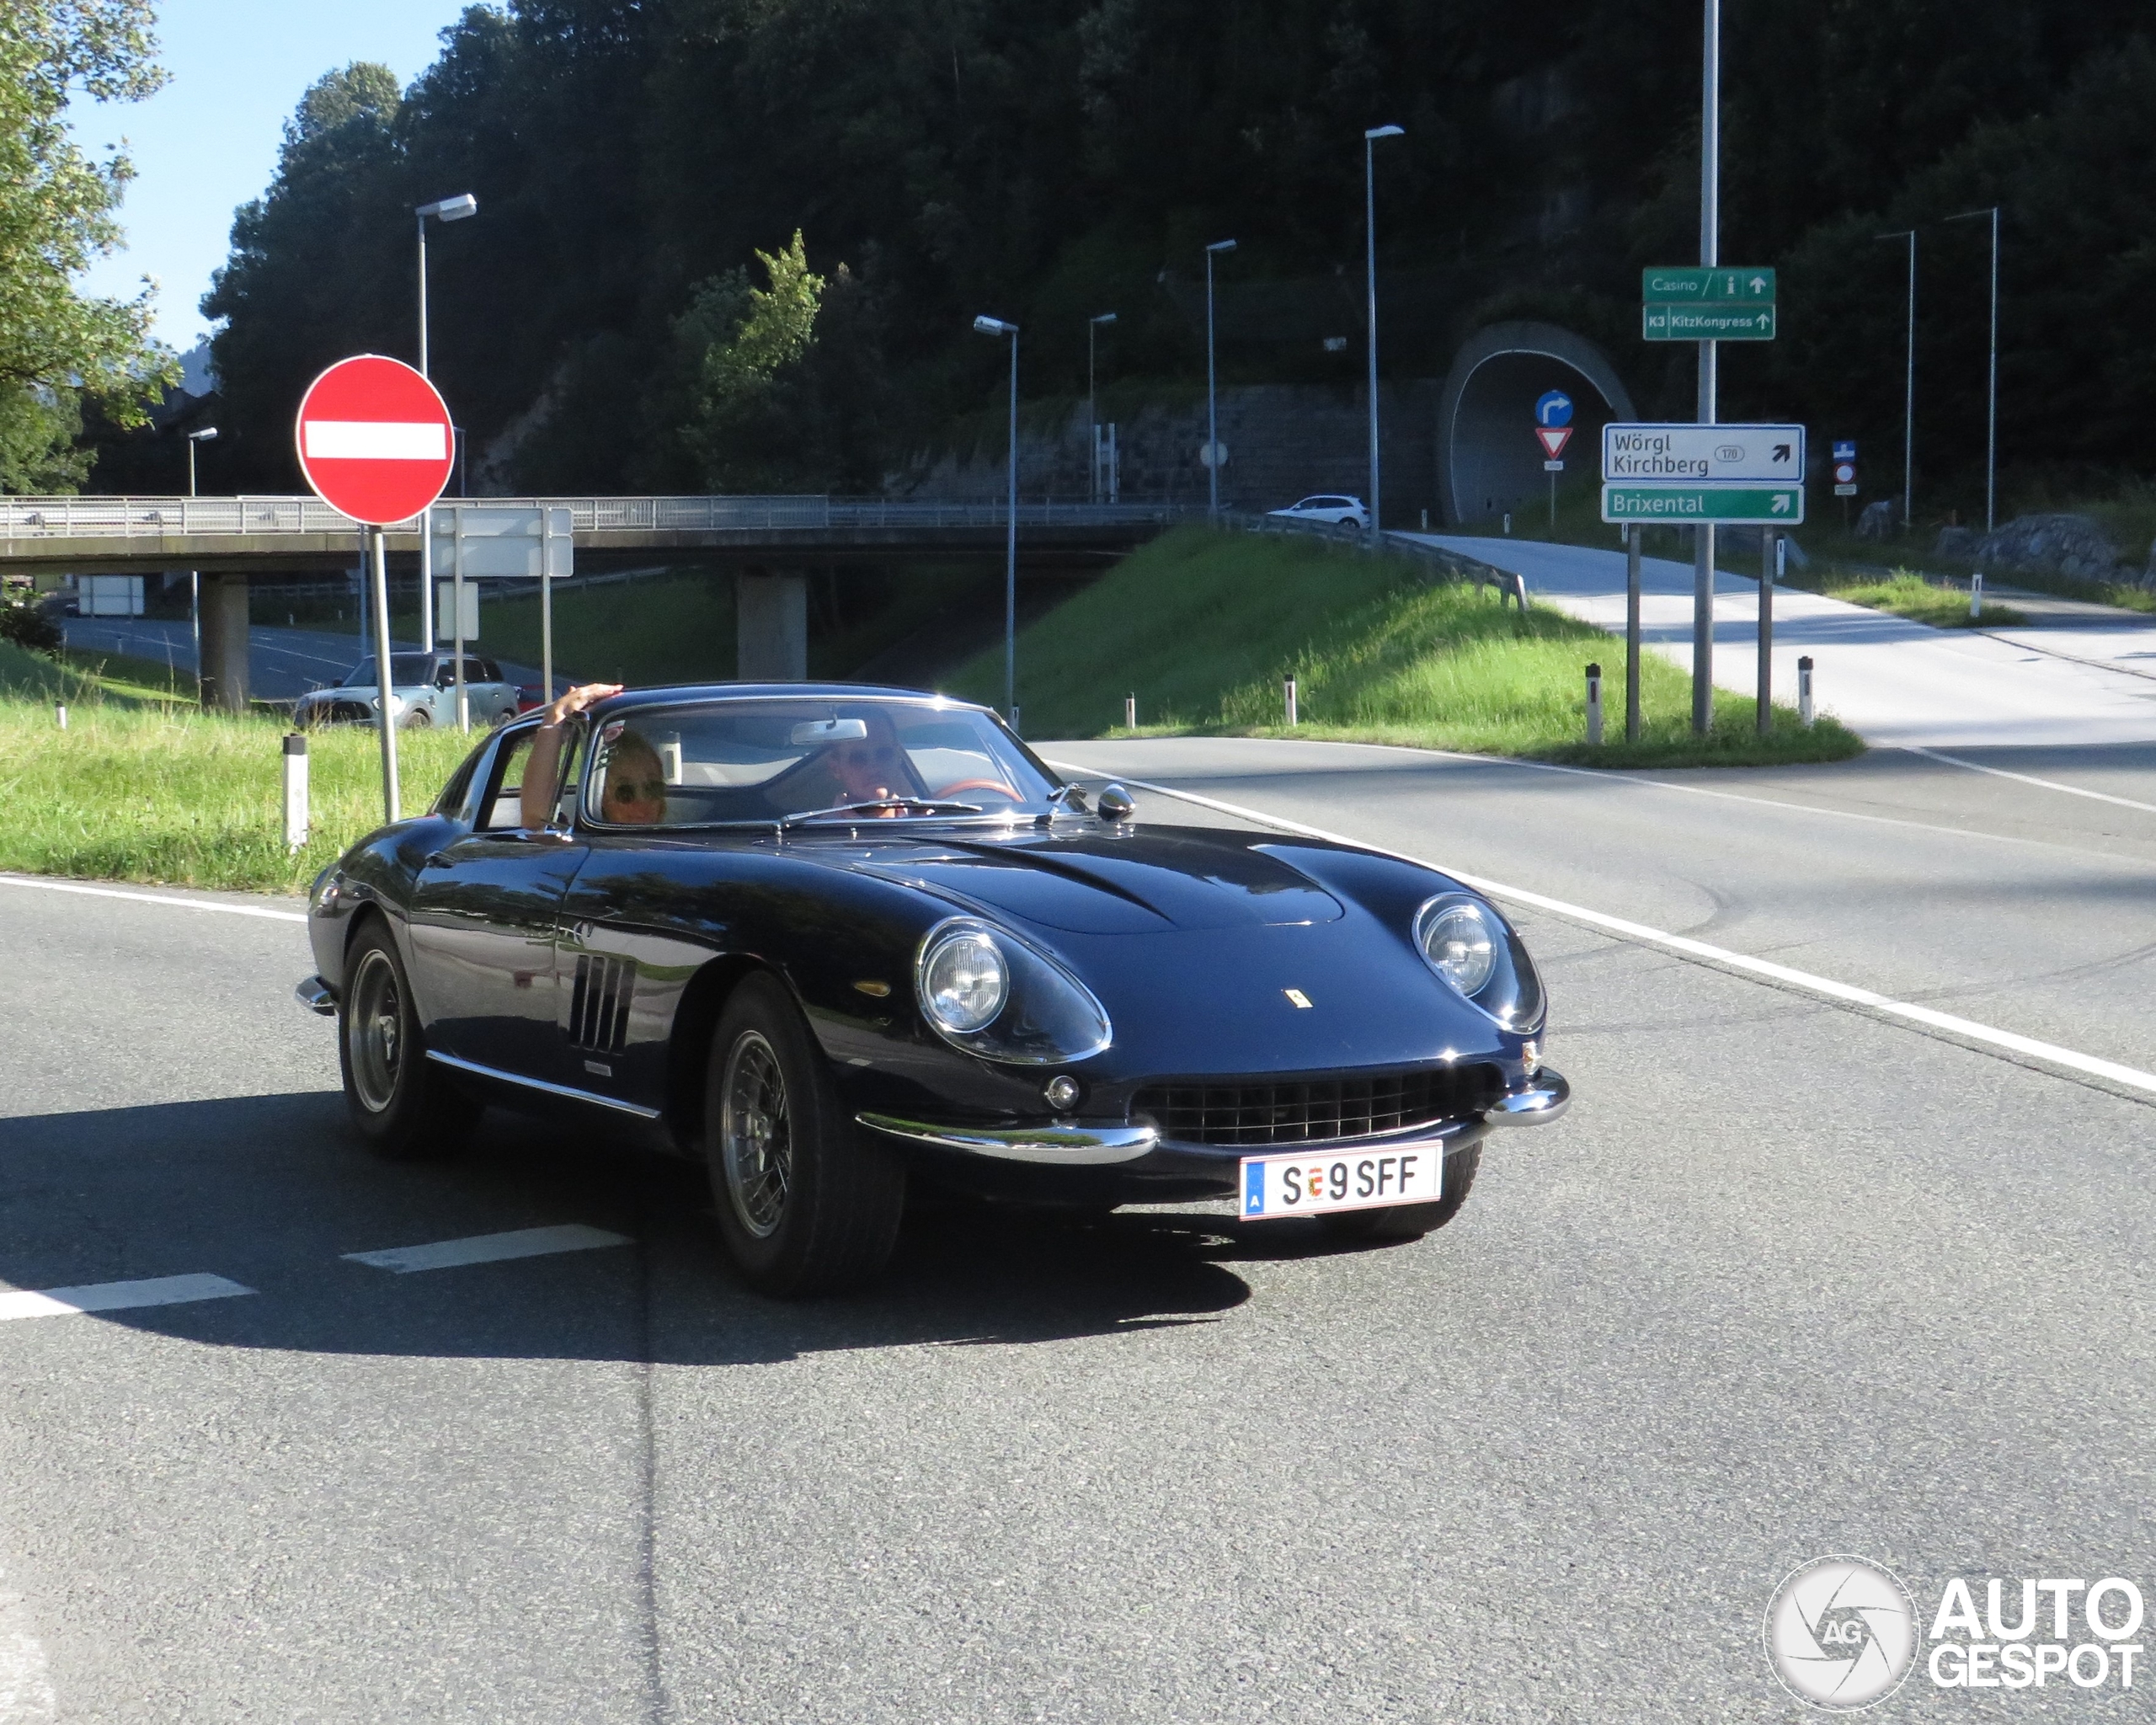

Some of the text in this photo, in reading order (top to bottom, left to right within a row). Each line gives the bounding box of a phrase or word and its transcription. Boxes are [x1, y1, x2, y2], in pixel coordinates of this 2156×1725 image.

[1652, 278, 1699, 291] Casino
[1648, 315, 1753, 329] K3 KitzKongress
[1614, 433, 1671, 456] Wörgl
[1721, 448, 1738, 460] 170
[1614, 456, 1709, 478] Kirchberg
[1613, 494, 1705, 513] Brixental
[1283, 1167, 1302, 1205] S
[1250, 1194, 1260, 1207] A
